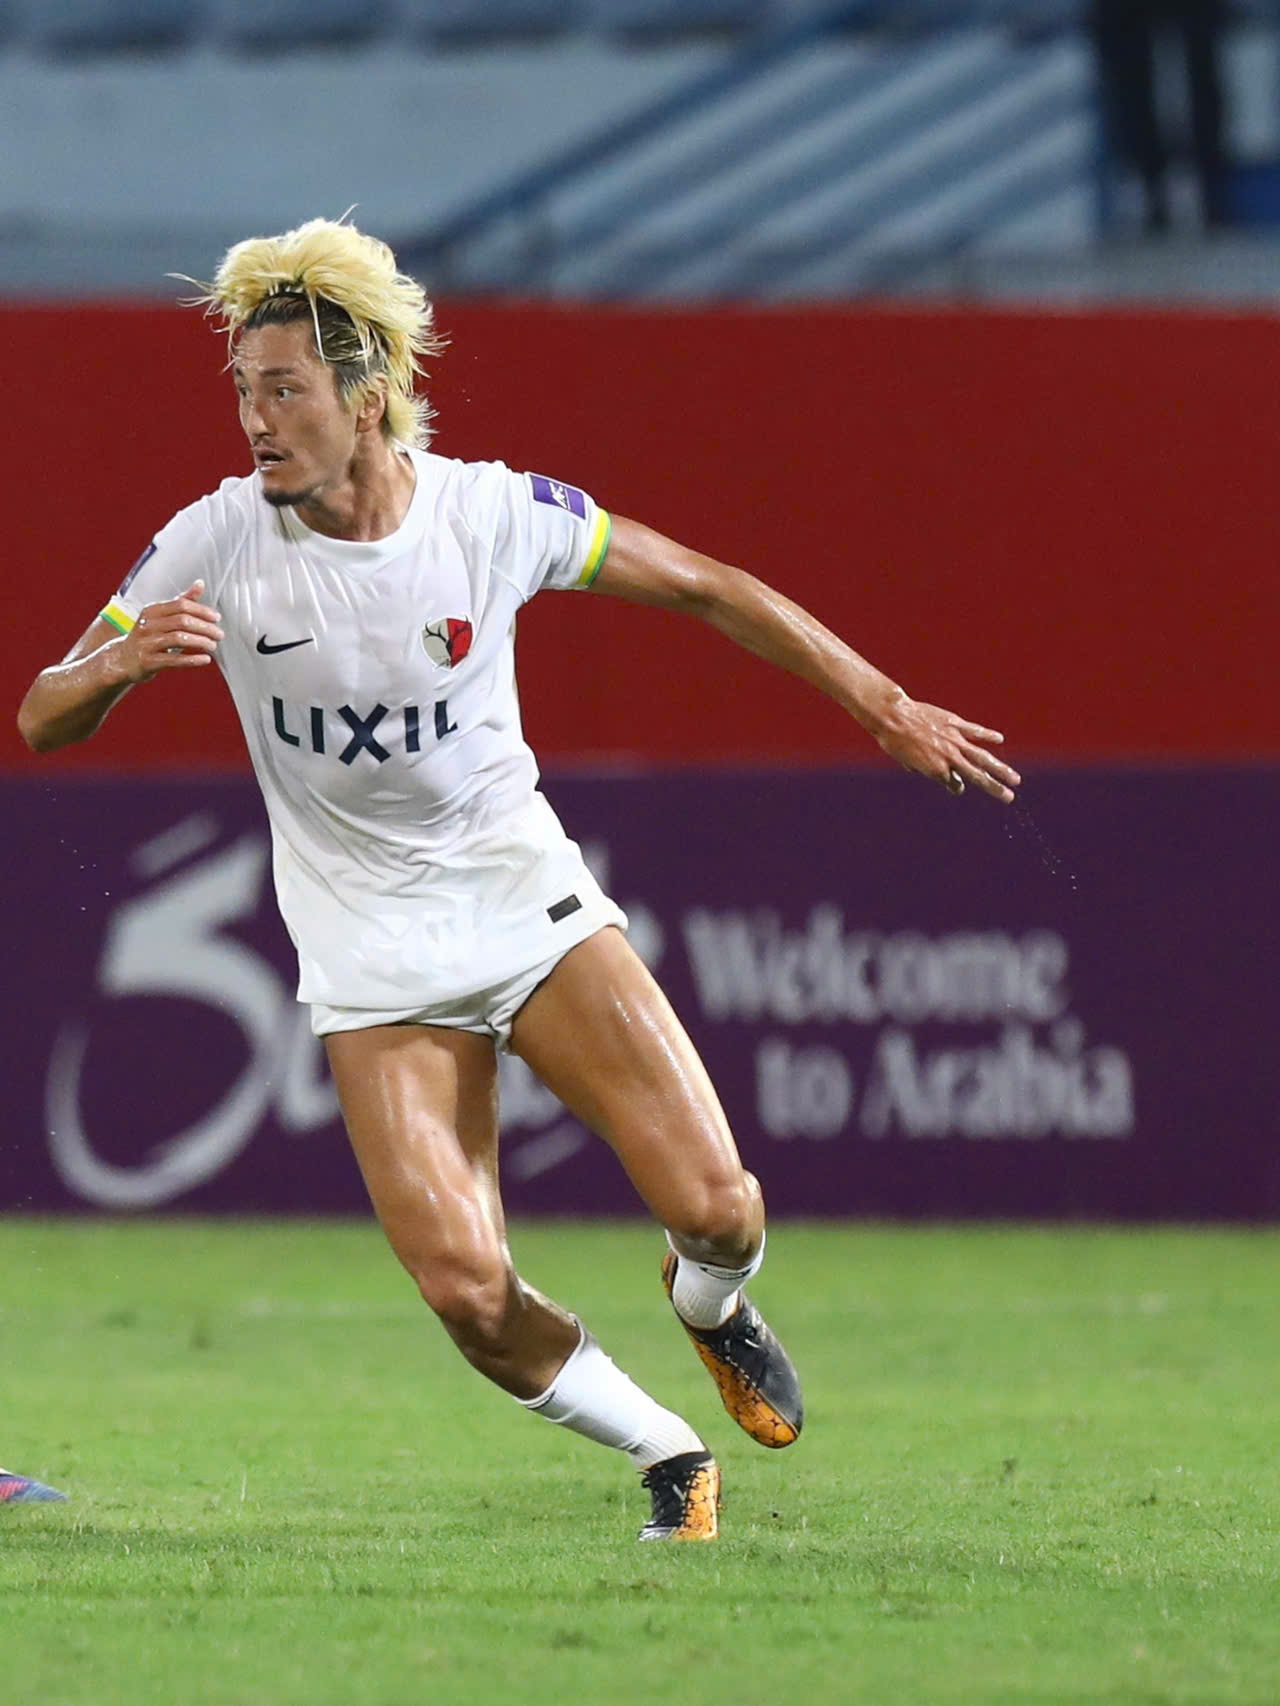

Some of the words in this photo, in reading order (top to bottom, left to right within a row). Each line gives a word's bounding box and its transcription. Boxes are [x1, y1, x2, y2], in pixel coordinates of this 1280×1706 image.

[272, 696, 459, 766] LIXIL
[685, 905, 1068, 1022] Welcome
[756, 1035, 850, 1136] to
[858, 1016, 1134, 1138] Arabia
